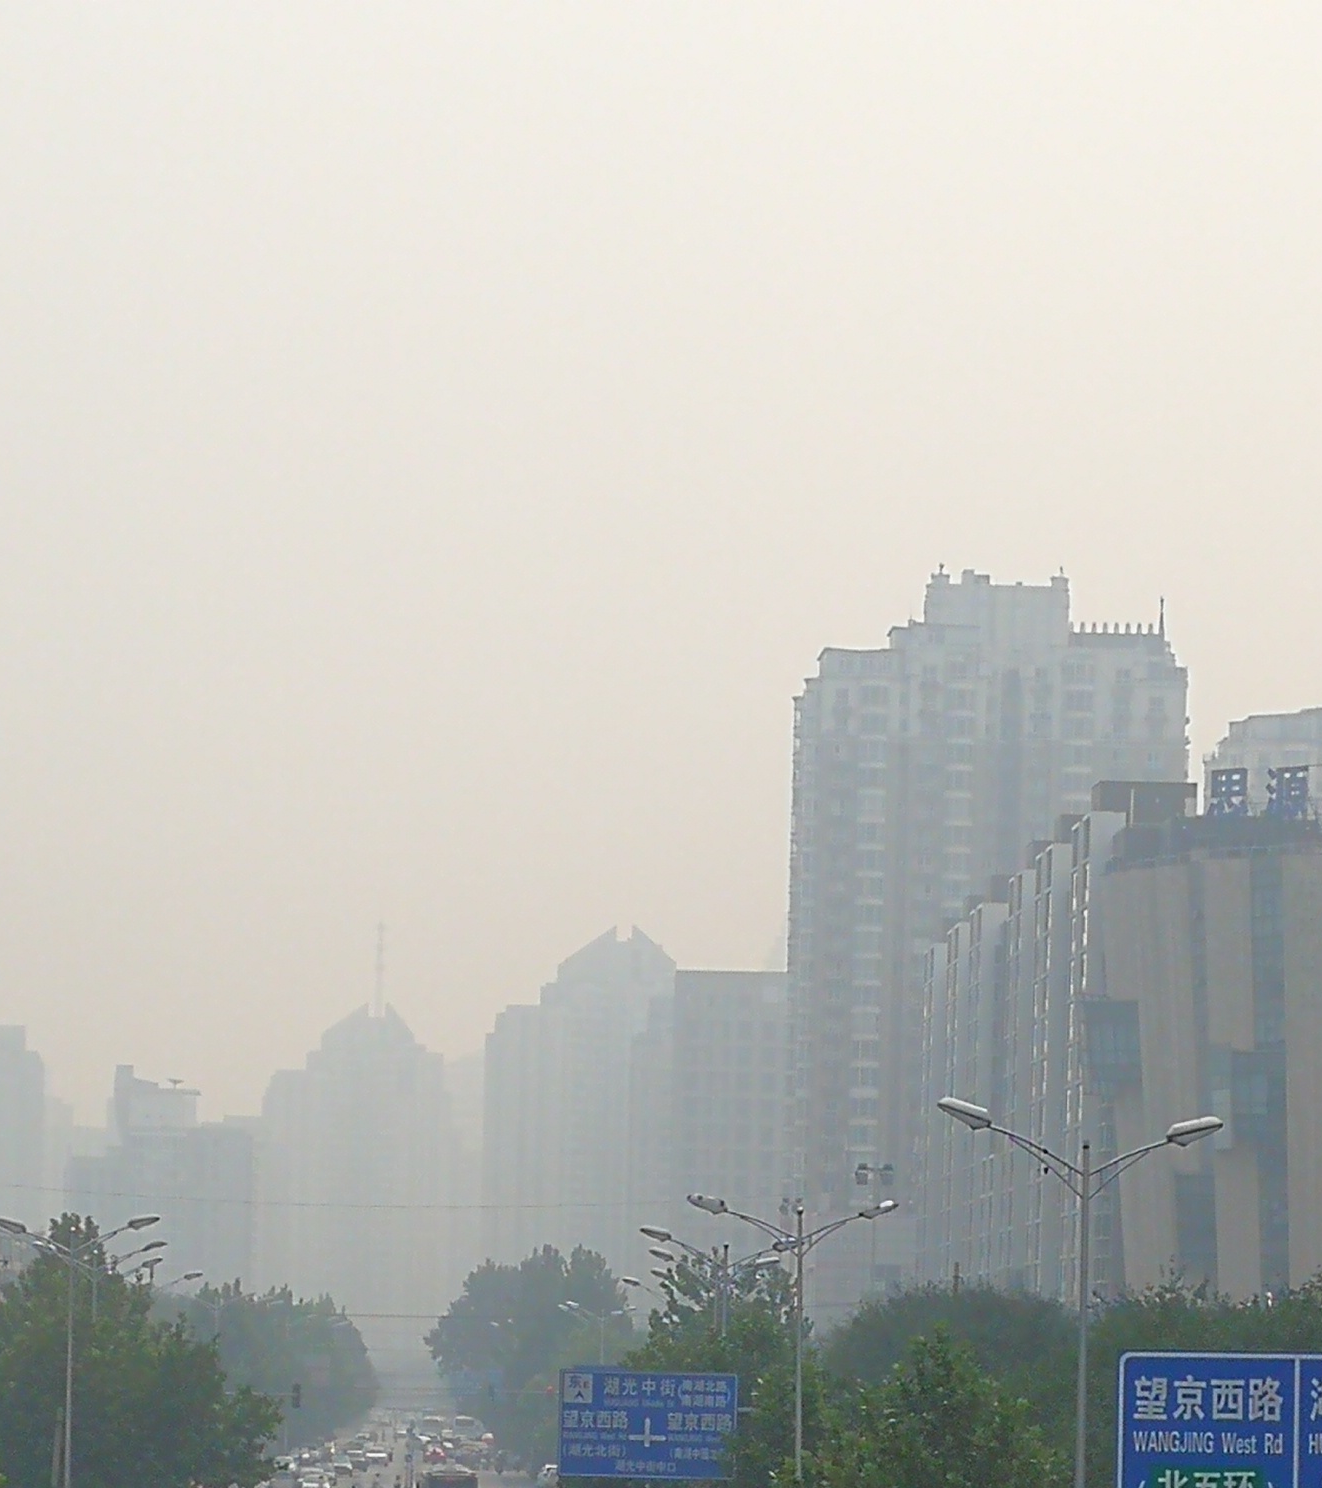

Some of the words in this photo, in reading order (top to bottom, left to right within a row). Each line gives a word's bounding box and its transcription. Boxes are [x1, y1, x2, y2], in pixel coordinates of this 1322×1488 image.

[603, 1377, 676, 1397] 湖光中街
[1133, 1375, 1283, 1422] 望京西路
[563, 1410, 628, 1428] 望京西路
[667, 1412, 732, 1432] 望京西路
[1133, 1431, 1214, 1453] WANGJING
[1222, 1433, 1257, 1454] West
[1265, 1433, 1283, 1454] Rd
